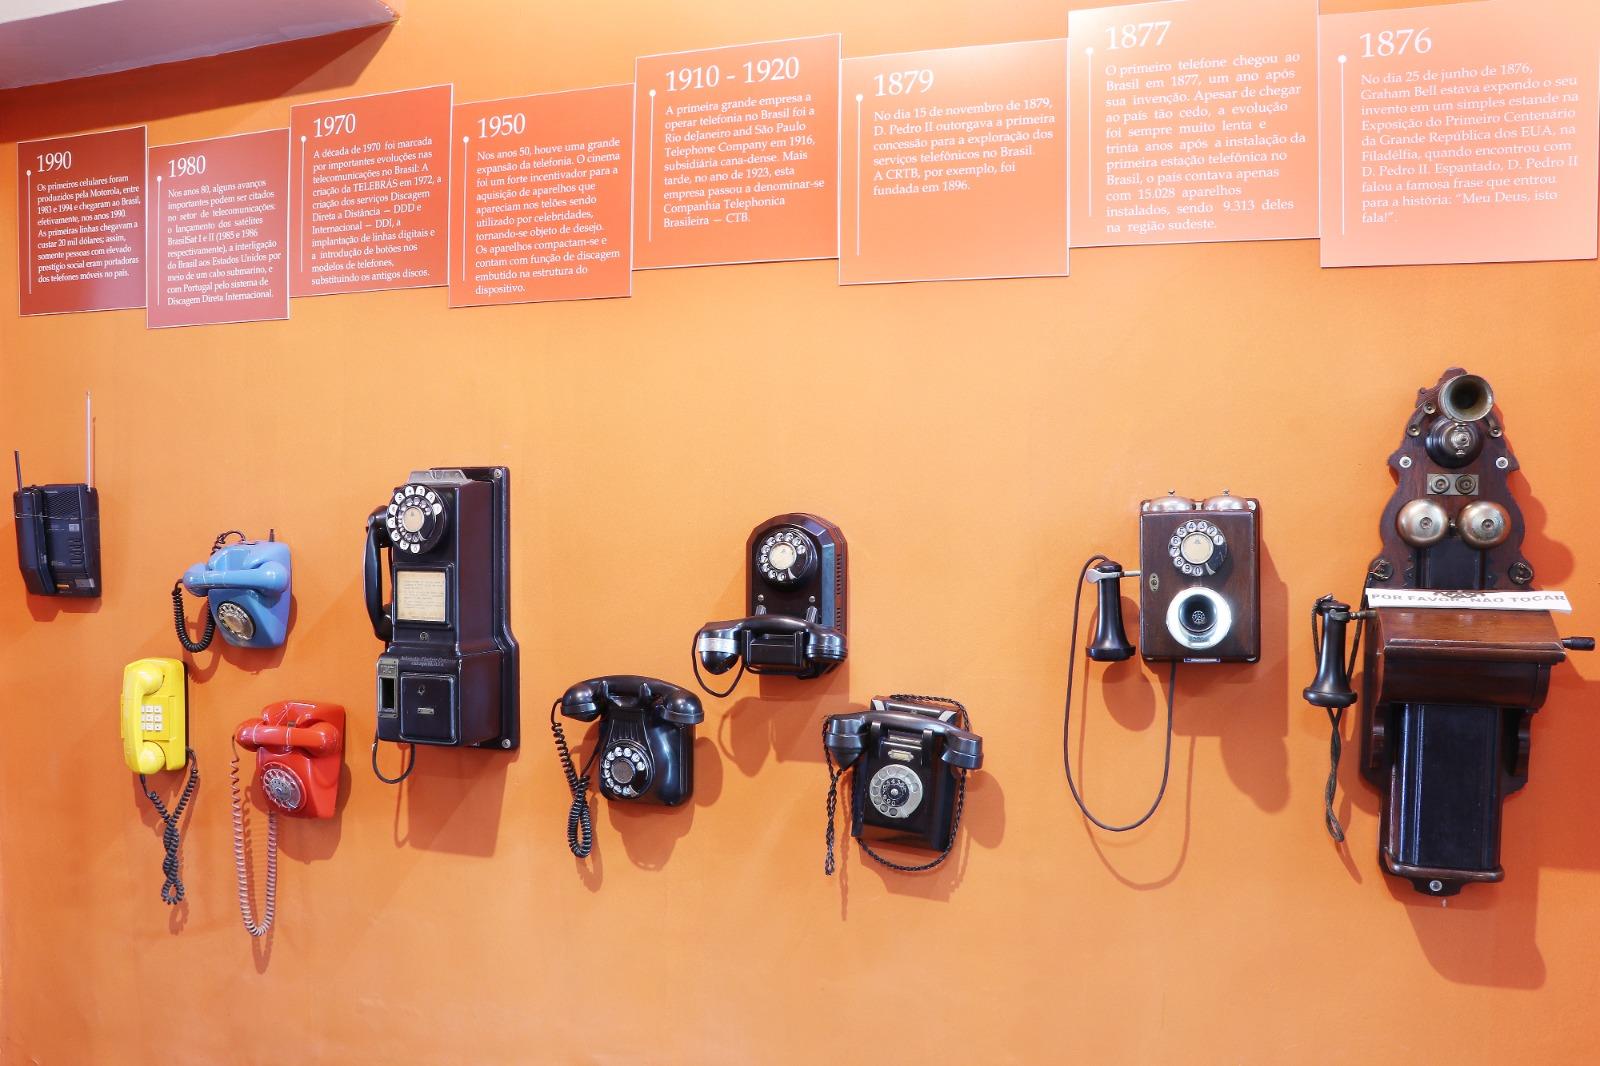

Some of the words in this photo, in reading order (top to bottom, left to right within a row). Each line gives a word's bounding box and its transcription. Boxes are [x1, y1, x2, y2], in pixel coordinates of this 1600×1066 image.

[1107, 19, 1171, 50] 1877
[1360, 26, 1432, 58] 1876
[665, 63, 719, 91] 1910
[743, 54, 799, 83] 1920
[1104, 64, 1117, 75] O
[1119, 60, 1172, 76] primeiro
[1177, 56, 1228, 70] telefone
[1232, 52, 1278, 69] chegou
[1284, 53, 1301, 62] ao
[1360, 74, 1380, 85] No
[1382, 72, 1403, 84] dia
[1405, 71, 1420, 82] 25
[1421, 70, 1439, 81] de
[1440, 66, 1478, 82] junho
[1479, 65, 1497, 76] de
[874, 67, 933, 96] 1879
[1106, 78, 1140, 90] Brasil
[1144, 78, 1165, 88] em
[1208, 74, 1229, 84] um
[1235, 72, 1260, 82] ano
[1265, 67, 1297, 83] após
[1360, 87, 1411, 101] Graham
[1414, 85, 1437, 97] Bell
[1440, 82, 1480, 95] estava
[1482, 78, 1541, 94] expondo
[1542, 79, 1552, 87] o
[1555, 77, 1578, 87] seu
[664, 105, 674, 115] A
[676, 101, 719, 116] primeira
[721, 97, 758, 112] grande
[758, 94, 803, 108] empresa
[804, 93, 812, 101] a
[1104, 97, 1127, 106] sua
[1193, 88, 1238, 103] Apesar
[1239, 86, 1257, 98] de
[1258, 83, 1302, 99] chegar
[873, 110, 892, 121] No
[893, 109, 911, 119] dia
[914, 107, 927, 118] 15
[928, 106, 944, 117] de
[945, 101, 1004, 115] novembro
[1005, 100, 1021, 111] de
[1360, 118, 1423, 134] Exposição
[1425, 116, 1442, 127] do
[1445, 112, 1501, 126] Primeiro
[1503, 107, 1576, 122] Centenário
[313, 112, 355, 137] 1970
[478, 111, 525, 138] 1950
[665, 132, 682, 143] Rio
[683, 128, 732, 141] deJaneiro
[732, 126, 753, 136] and
[754, 124, 774, 134] São
[776, 121, 807, 132] Paulo
[889, 123, 922, 134] Pedro
[924, 122, 934, 132] II
[935, 117, 993, 134] outorgava
[995, 118, 1003, 127] a
[1005, 113, 1056, 128] primeira
[664, 143, 717, 159] Telephone
[717, 139, 768, 154] Company
[769, 139, 787, 147] em
[873, 153, 918, 168] serviços
[920, 148, 981, 162] telefônicos
[981, 149, 998, 158] no
[1424, 146, 1473, 161] quando
[1475, 141, 1540, 155] encontrou
[1543, 141, 1572, 151] com
[37, 150, 71, 172] 1990
[168, 154, 205, 177] 1980
[476, 161, 518, 176] expansão
[518, 160, 531, 170] da
[586, 151, 621, 163] cinema
[476, 188, 518, 203] aquisição
[518, 187, 531, 197] de
[532, 183, 577, 198] aparelhos
[578, 182, 596, 193] que
[1105, 192, 1132, 201] com
[1138, 188, 1176, 199] 15.028
[1181, 185, 1243, 200] aparelhos
[1176, 202, 1214, 214] sendo
[1223, 200, 1256, 212] 9.313
[1261, 198, 1295, 210] deles
[476, 215, 515, 227] utilizado
[516, 215, 533, 226] por
[1371, 593, 1402, 601] POR
[1509, 595, 1566, 603] TOCAR
